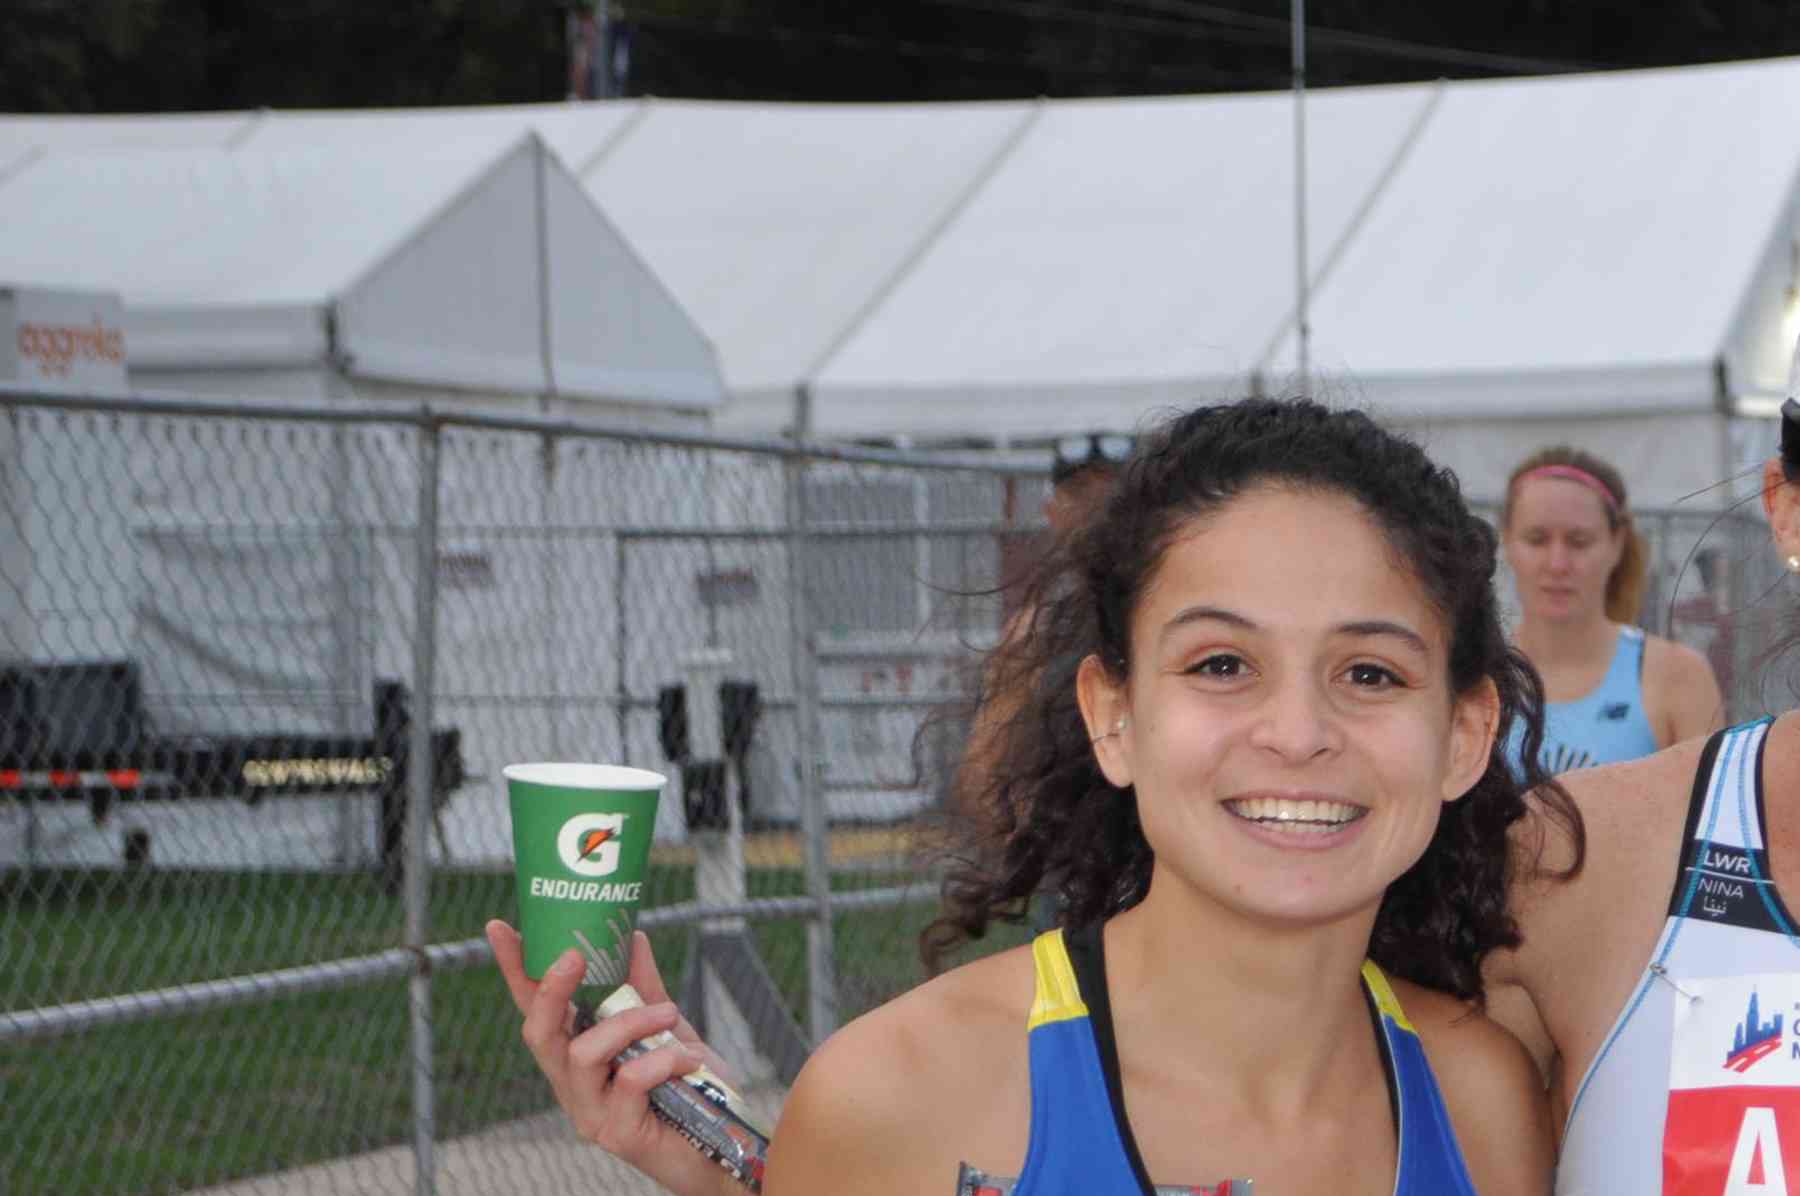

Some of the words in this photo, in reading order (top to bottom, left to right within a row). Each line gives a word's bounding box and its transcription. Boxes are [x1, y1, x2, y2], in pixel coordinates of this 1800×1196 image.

[557, 812, 624, 877] G
[531, 877, 642, 902] ENDURANCE
[1698, 878, 1744, 898] NINA
